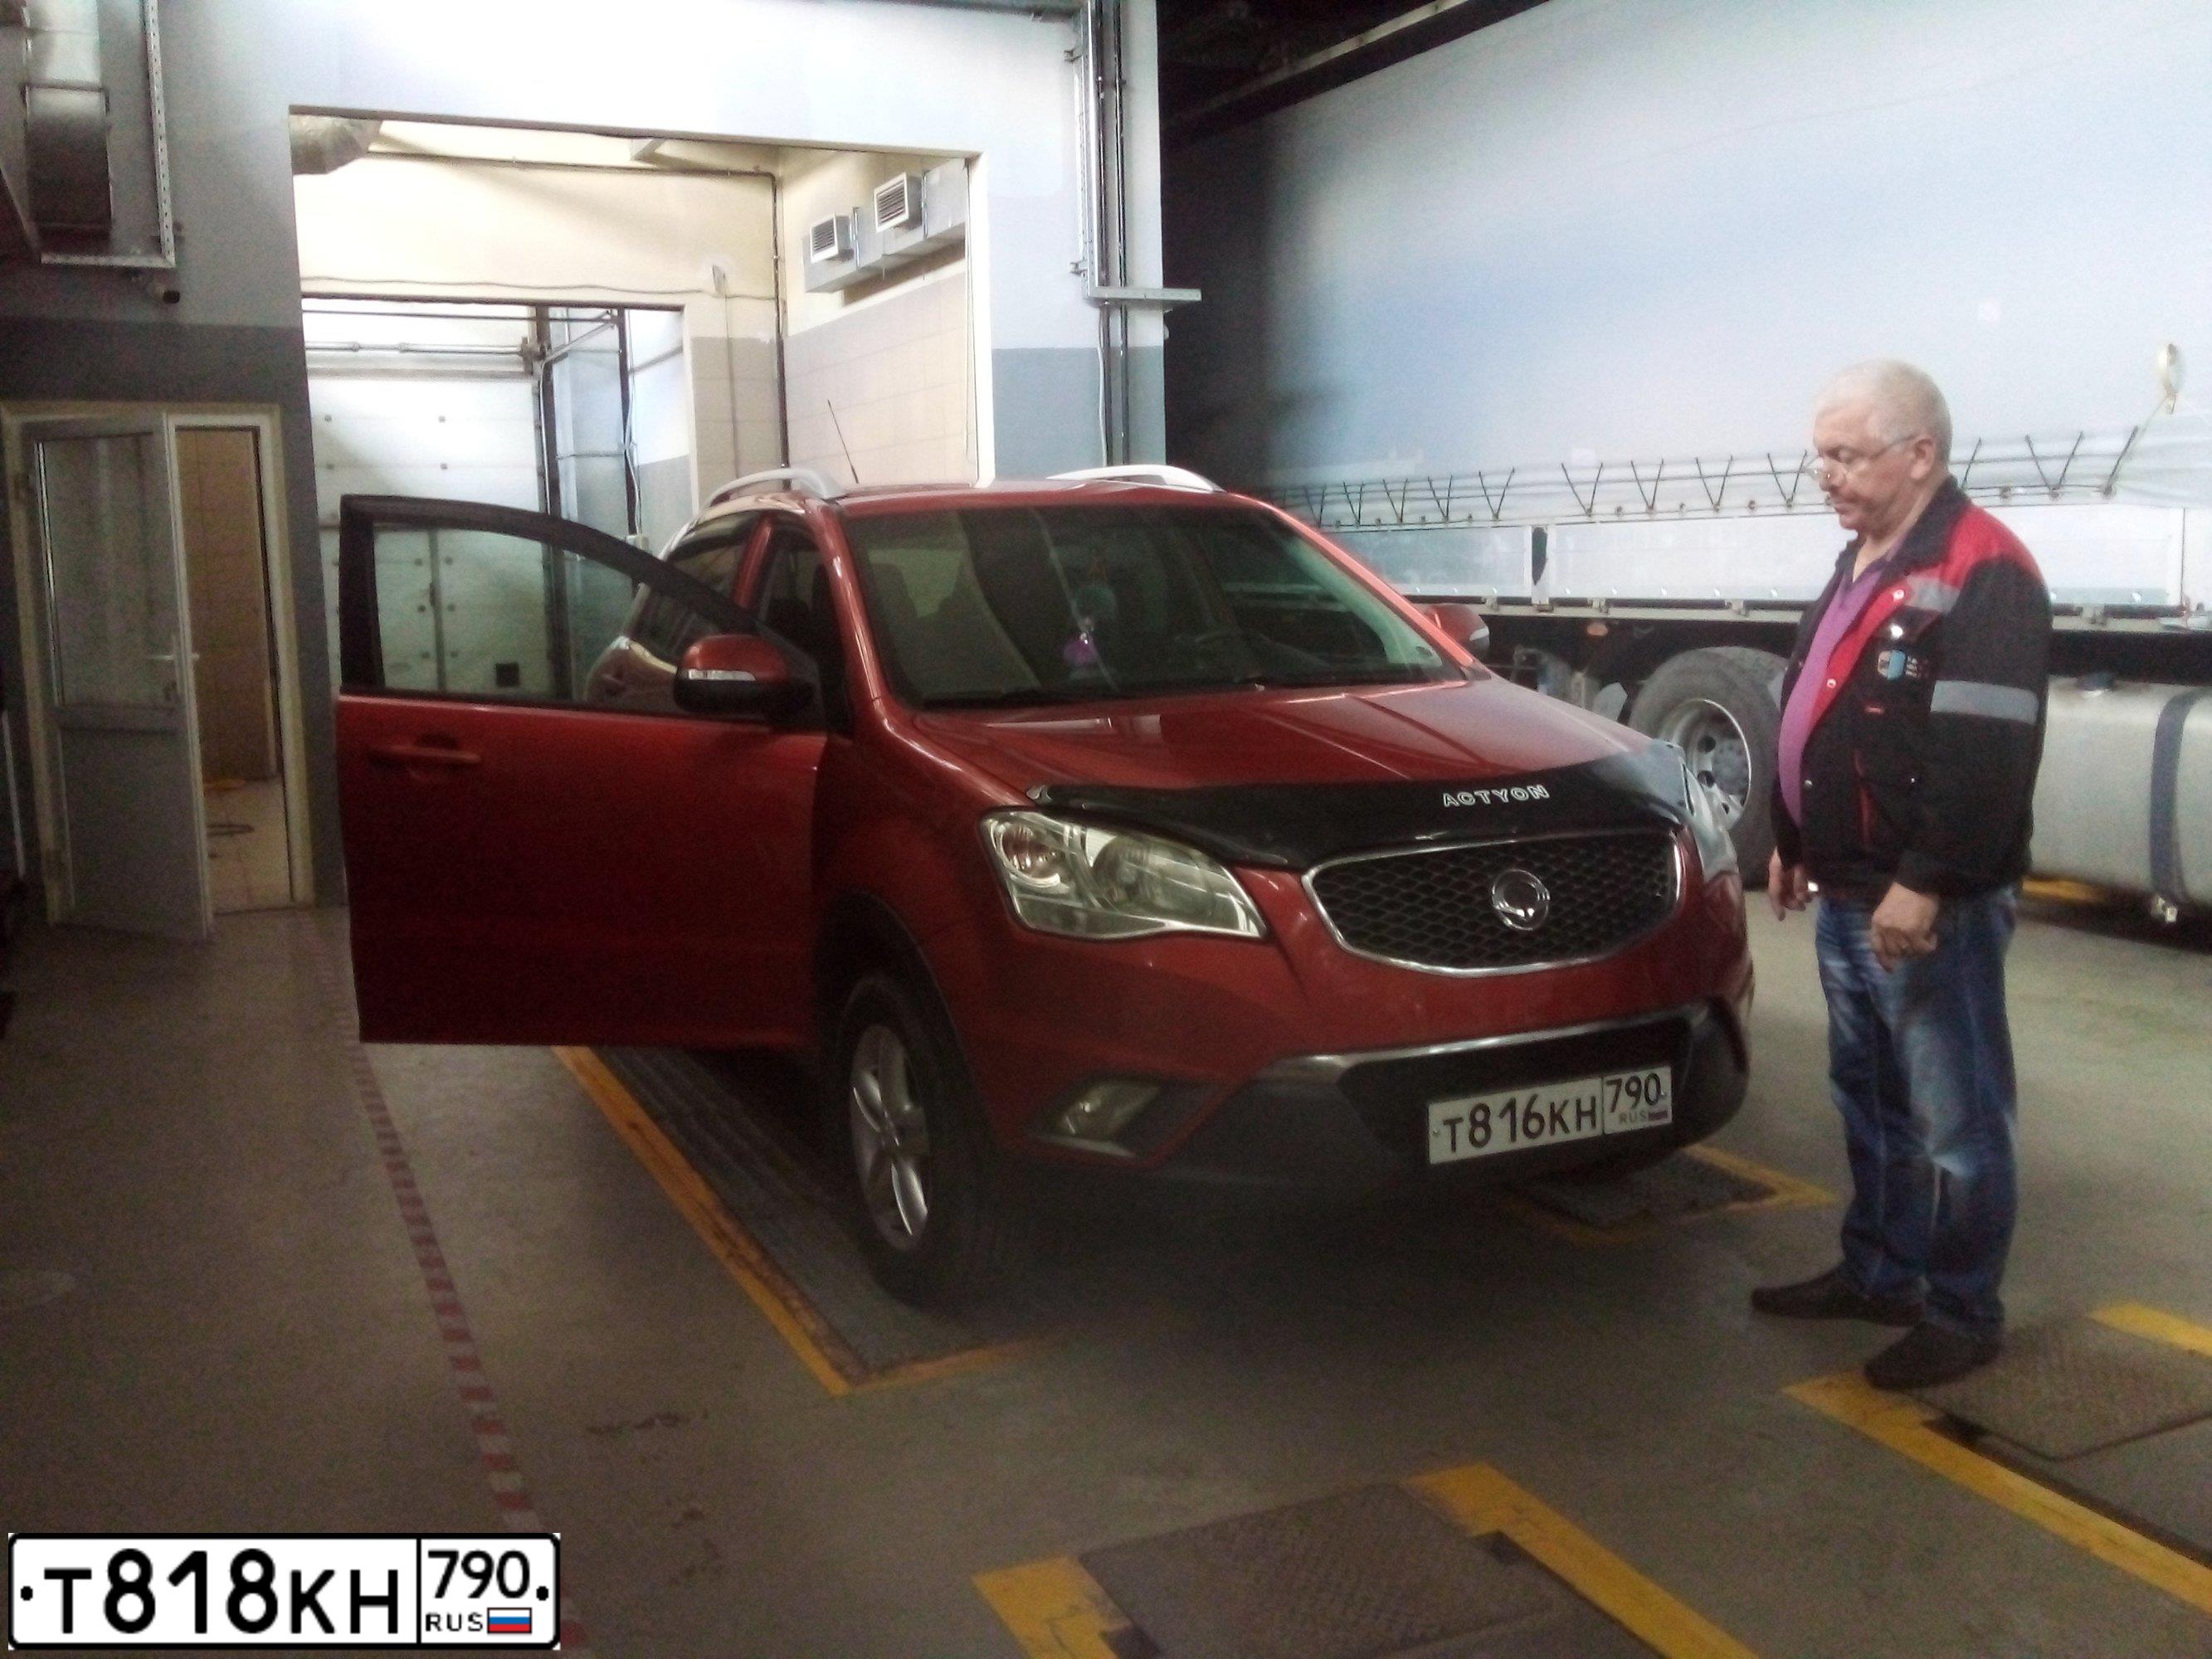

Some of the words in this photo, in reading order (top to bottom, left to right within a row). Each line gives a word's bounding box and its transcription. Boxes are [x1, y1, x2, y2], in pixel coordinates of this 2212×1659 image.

[1443, 784, 1550, 807] ACTYON
[1443, 1094, 1597, 1154] T816KH
[1605, 1073, 1662, 1114] 790
